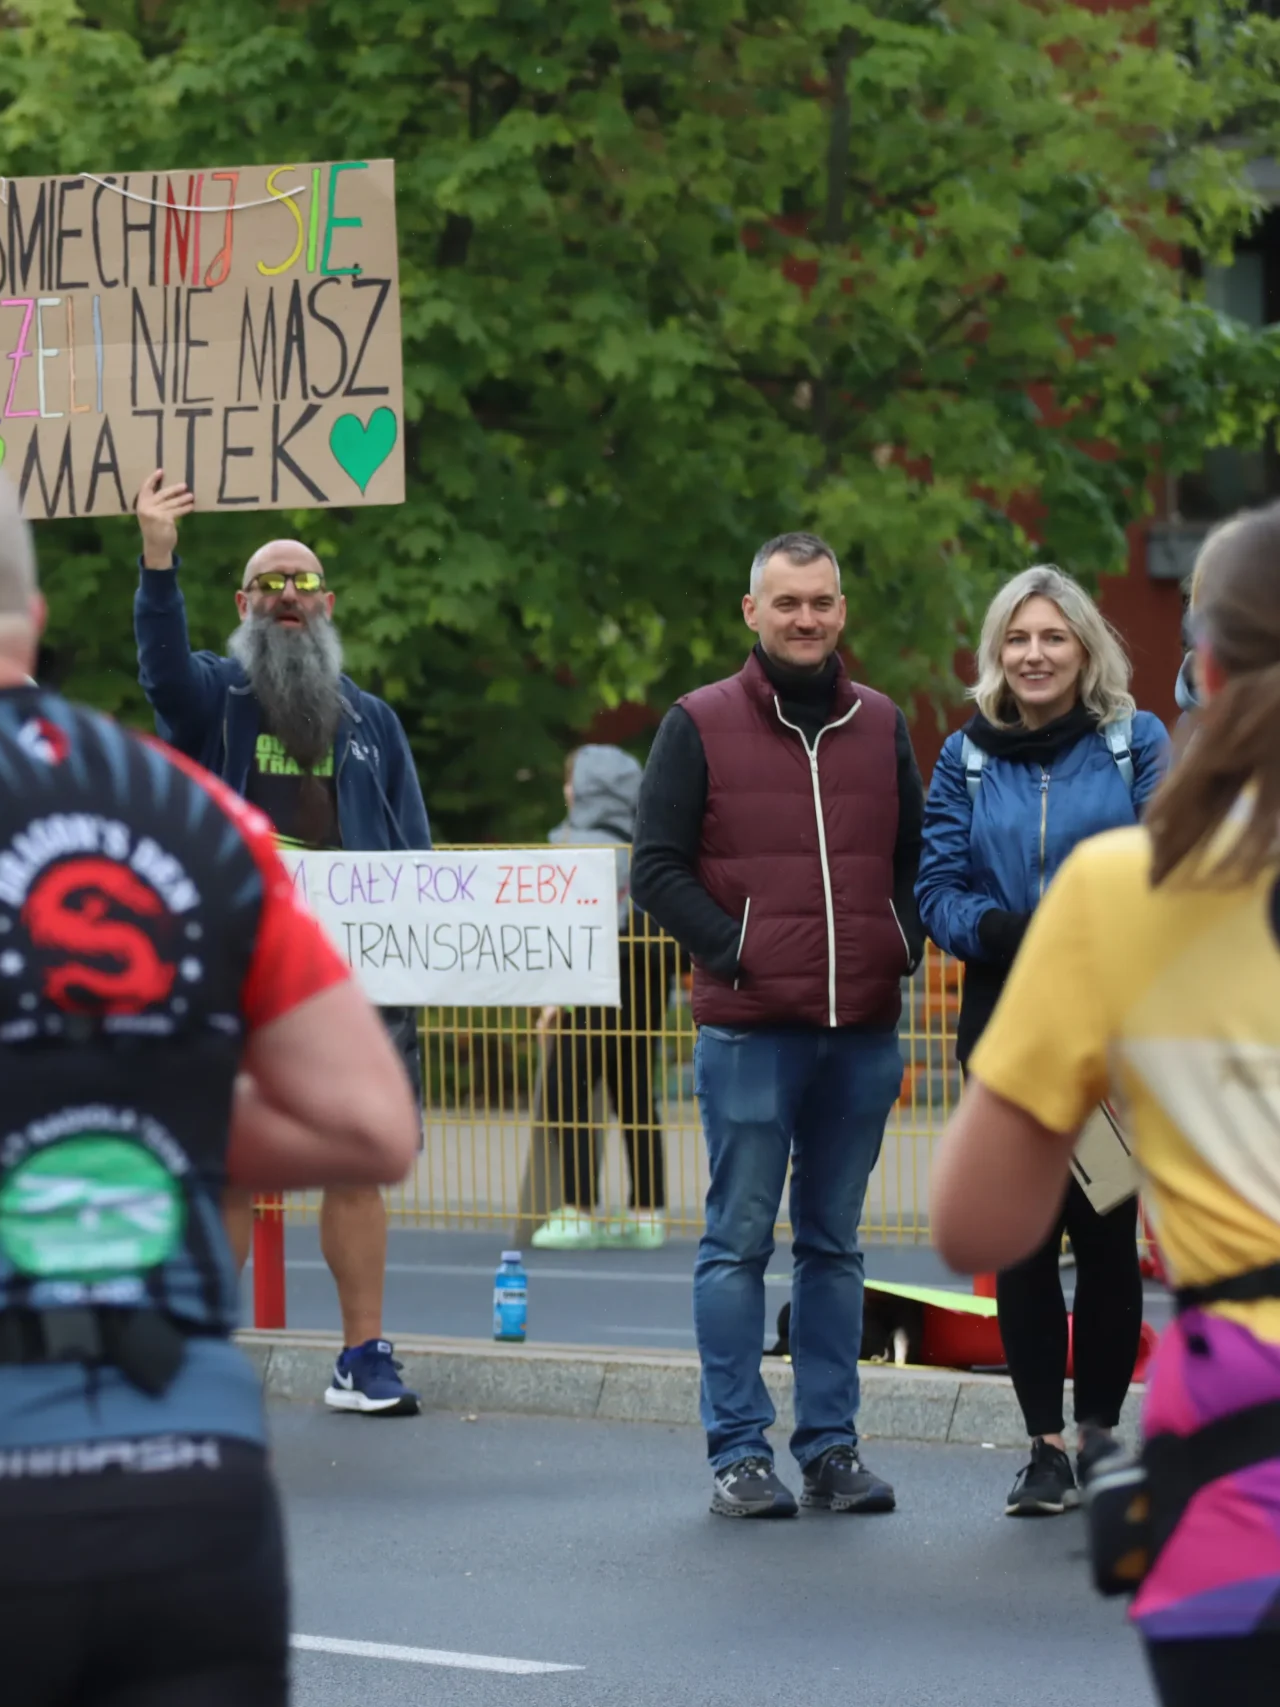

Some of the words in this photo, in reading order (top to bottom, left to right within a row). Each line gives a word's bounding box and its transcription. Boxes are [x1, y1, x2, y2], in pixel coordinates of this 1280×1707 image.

[131, 285, 215, 407] NIE
[237, 278, 392, 402] MASZ
[19, 402, 331, 519] MAJTEK
[327, 860, 404, 907] CAŁY
[415, 863, 479, 905] ROK
[341, 921, 603, 972] TRANSPARENT
